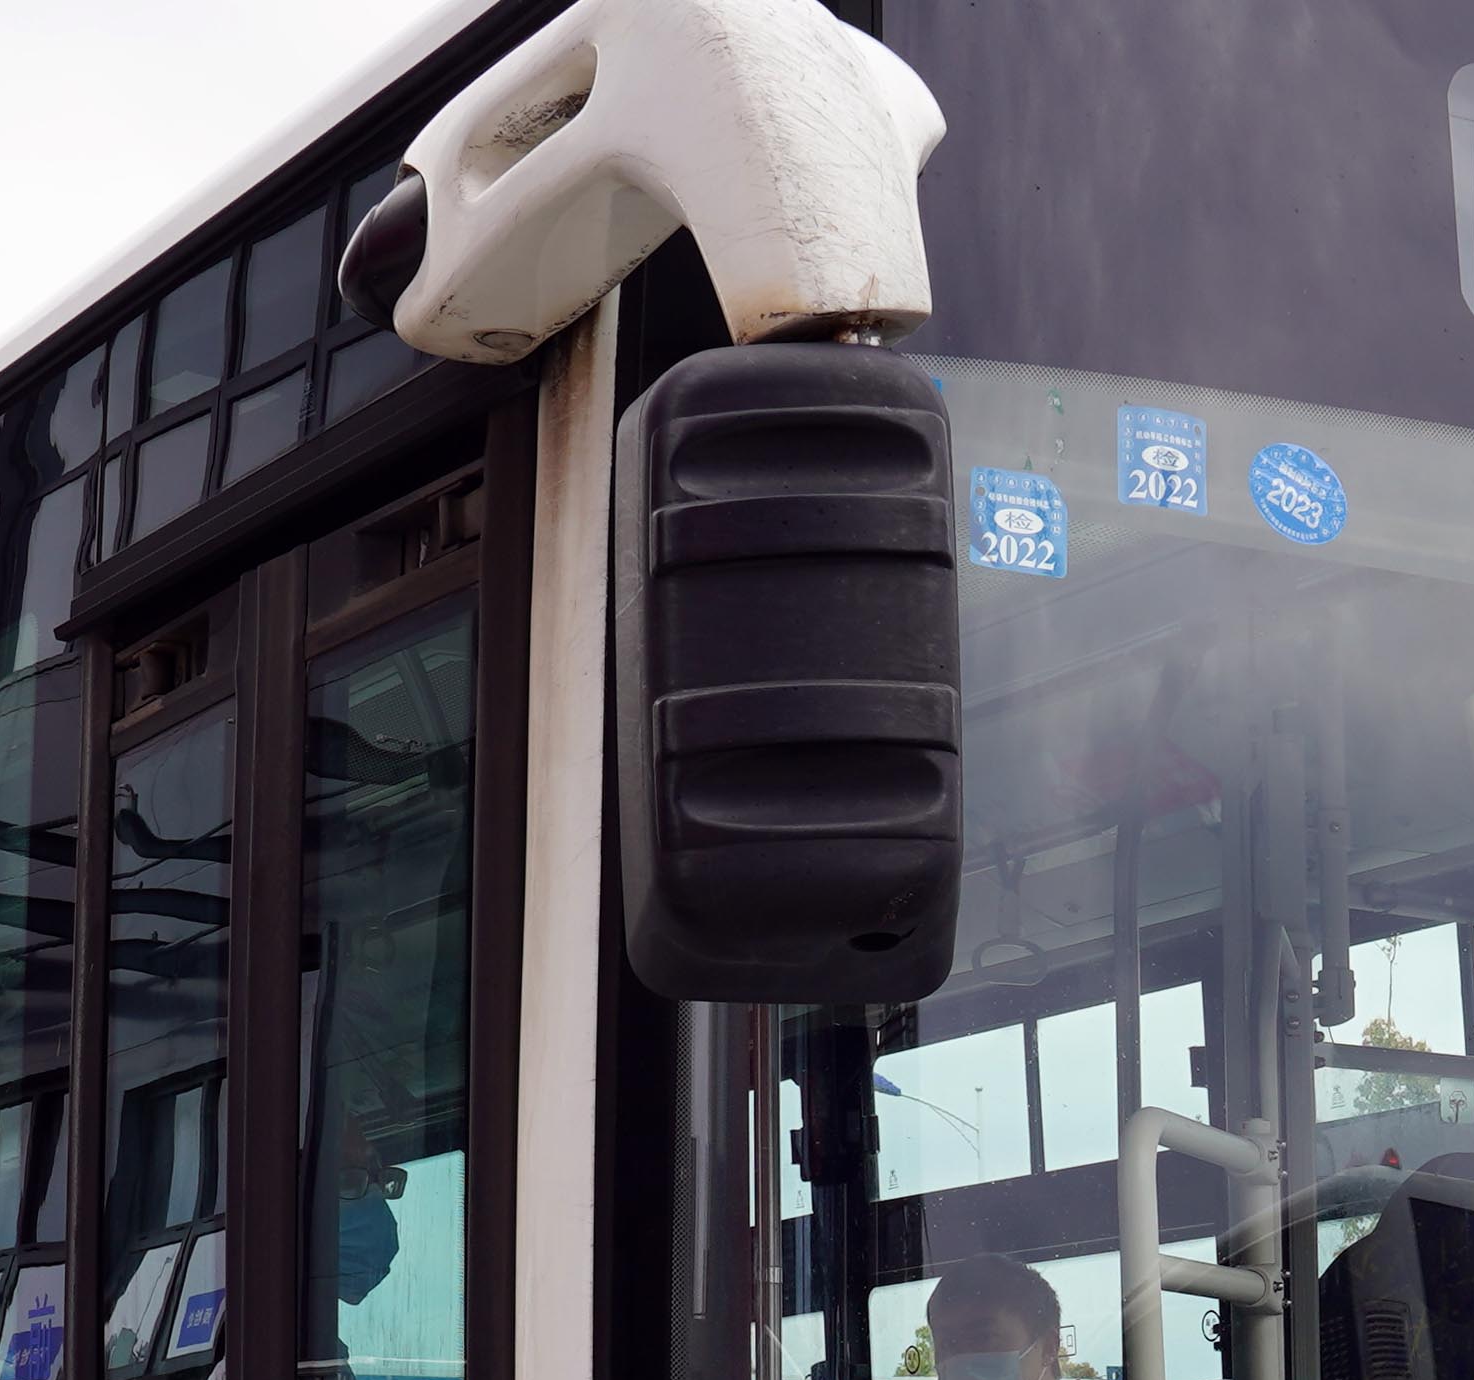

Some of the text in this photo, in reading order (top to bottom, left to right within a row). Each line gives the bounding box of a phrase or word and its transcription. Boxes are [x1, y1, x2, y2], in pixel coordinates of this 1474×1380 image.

[1128, 469, 1199, 508] 2022
[1266, 478, 1324, 529] 2023
[1005, 511, 1034, 531] 检
[980, 531, 1057, 571] 2022
